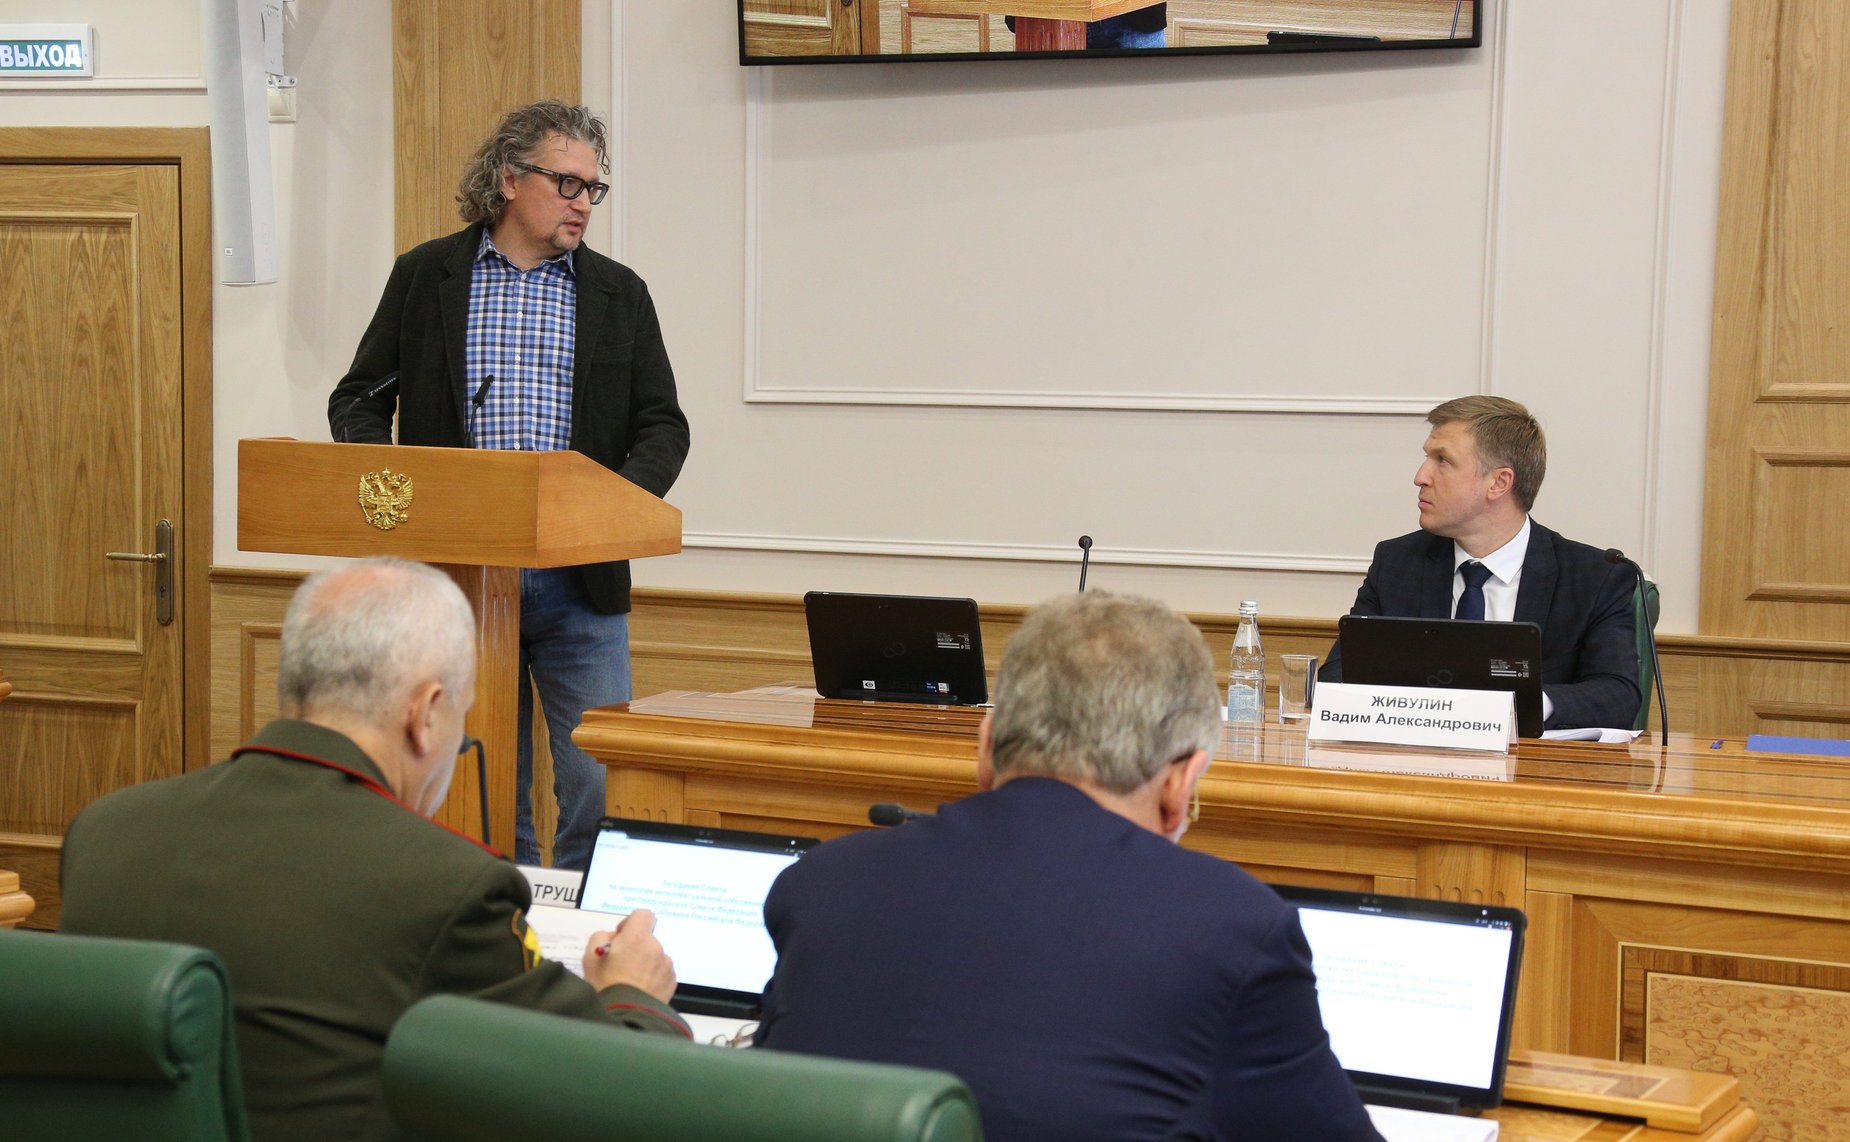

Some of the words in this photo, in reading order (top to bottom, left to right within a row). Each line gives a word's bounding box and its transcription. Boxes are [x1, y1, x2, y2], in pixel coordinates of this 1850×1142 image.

[0, 44, 82, 68] ВЫХОД
[1371, 695, 1453, 711] ЖИВУЛИН
[1320, 709, 1371, 725] Вадим
[1375, 713, 1501, 732] Александрович
